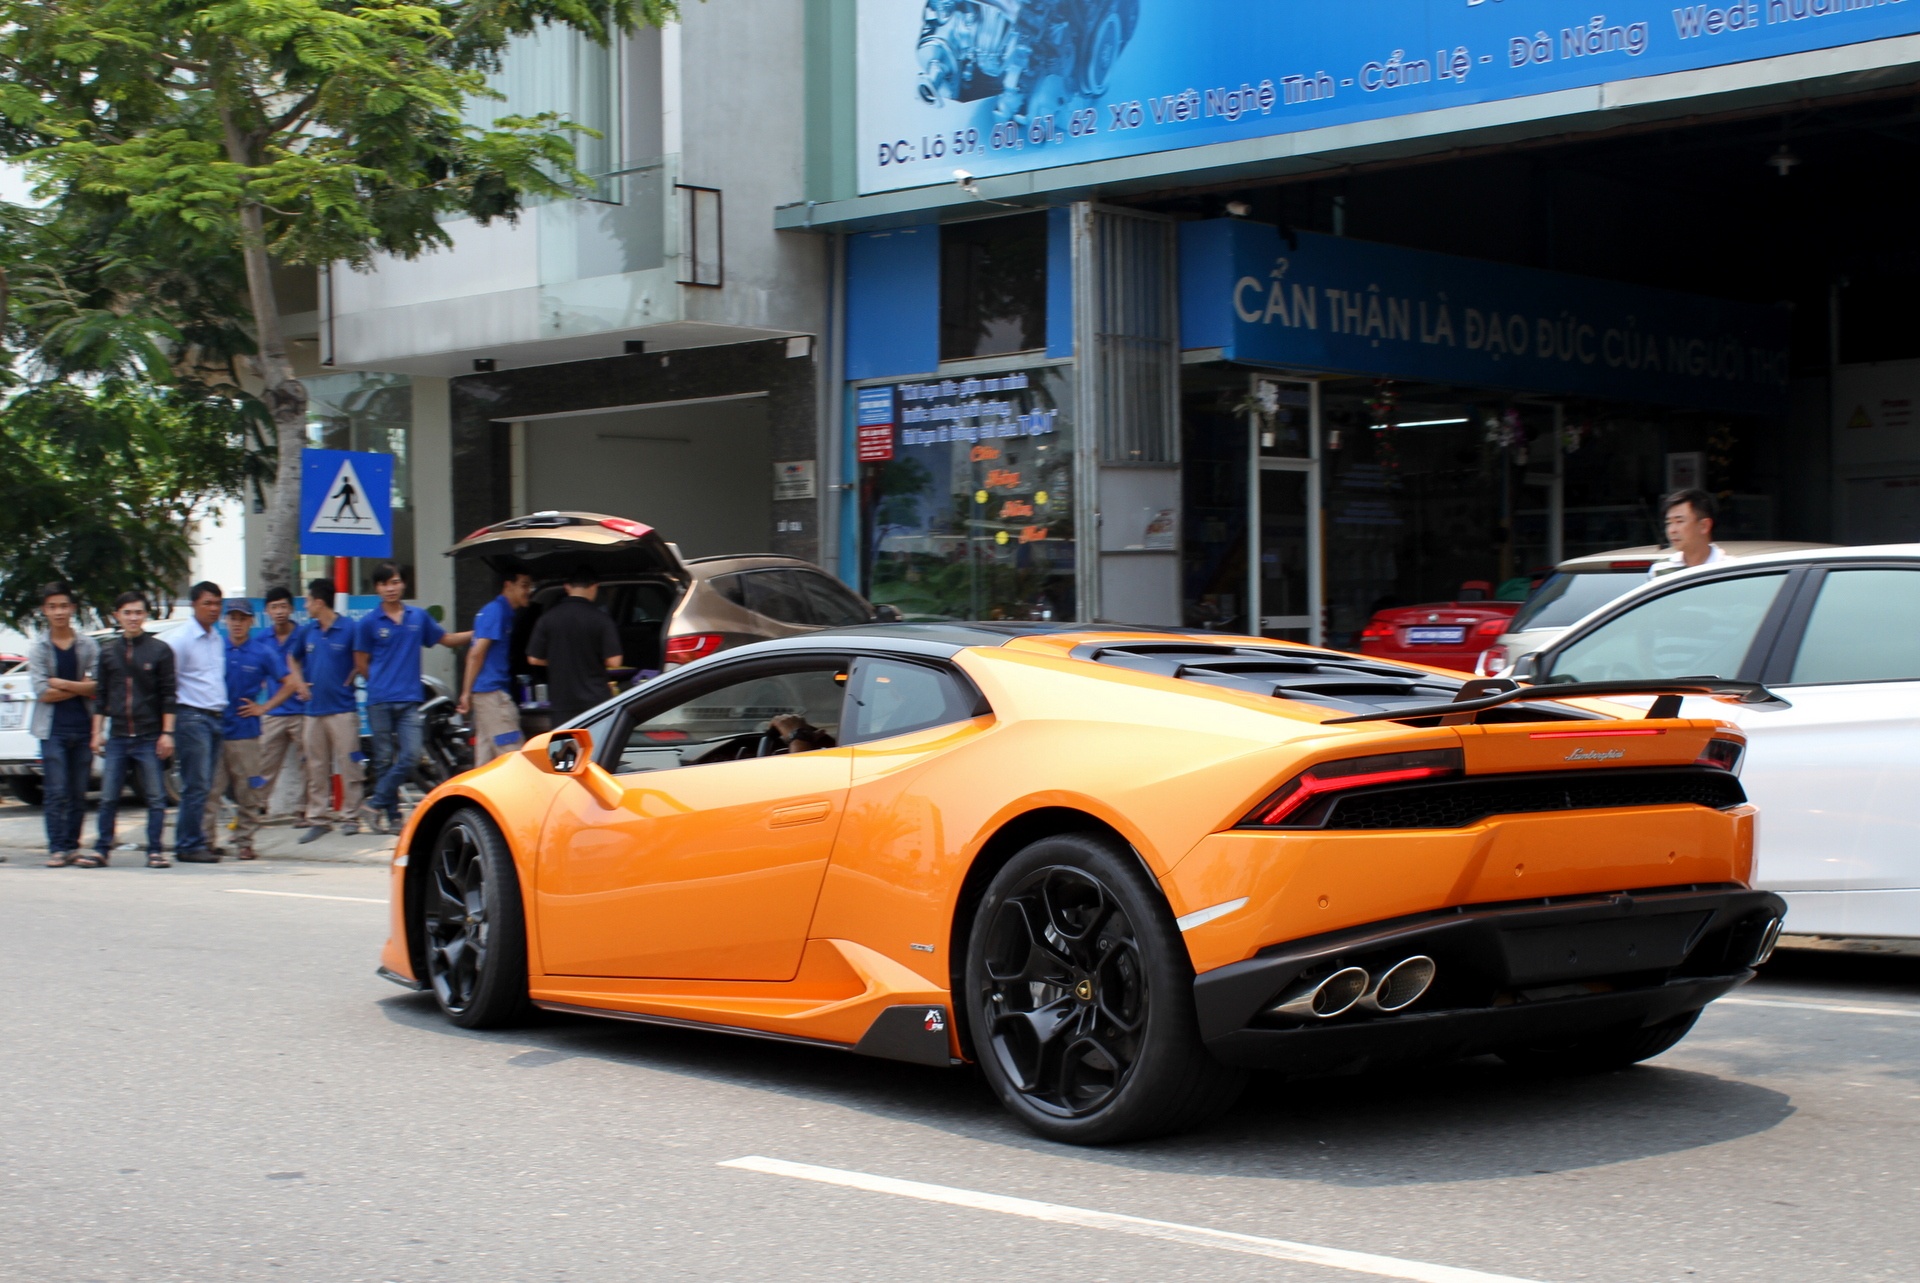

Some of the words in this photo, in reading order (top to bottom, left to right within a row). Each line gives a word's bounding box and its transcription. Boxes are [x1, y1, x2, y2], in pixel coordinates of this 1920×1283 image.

[878, 139, 916, 167] ĐC:
[922, 134, 946, 160] Lô
[952, 127, 984, 156] 59,
[990, 121, 1024, 150] 60,
[1028, 114, 1063, 144] 61,
[1069, 107, 1098, 138] 62
[1108, 100, 1144, 132] Xô
[1148, 88, 1201, 125] Viết
[1205, 79, 1276, 121] Nghệ
[1359, 49, 1430, 92] Cẩm
[1436, 46, 1472, 83] Lệ
[1509, 30, 1553, 69] Đà
[1671, 0, 1759, 40] Wed:
[1233, 257, 1317, 330] CẨN
[1325, 283, 1411, 348] THẬN
[1419, 291, 1456, 348] LÀ
[1464, 308, 1530, 361] ĐẠO
[1536, 310, 1599, 365] ĐỨC
[1602, 314, 1662, 371] CỦA
[1564, 747, 1626, 761] Lamborghini
